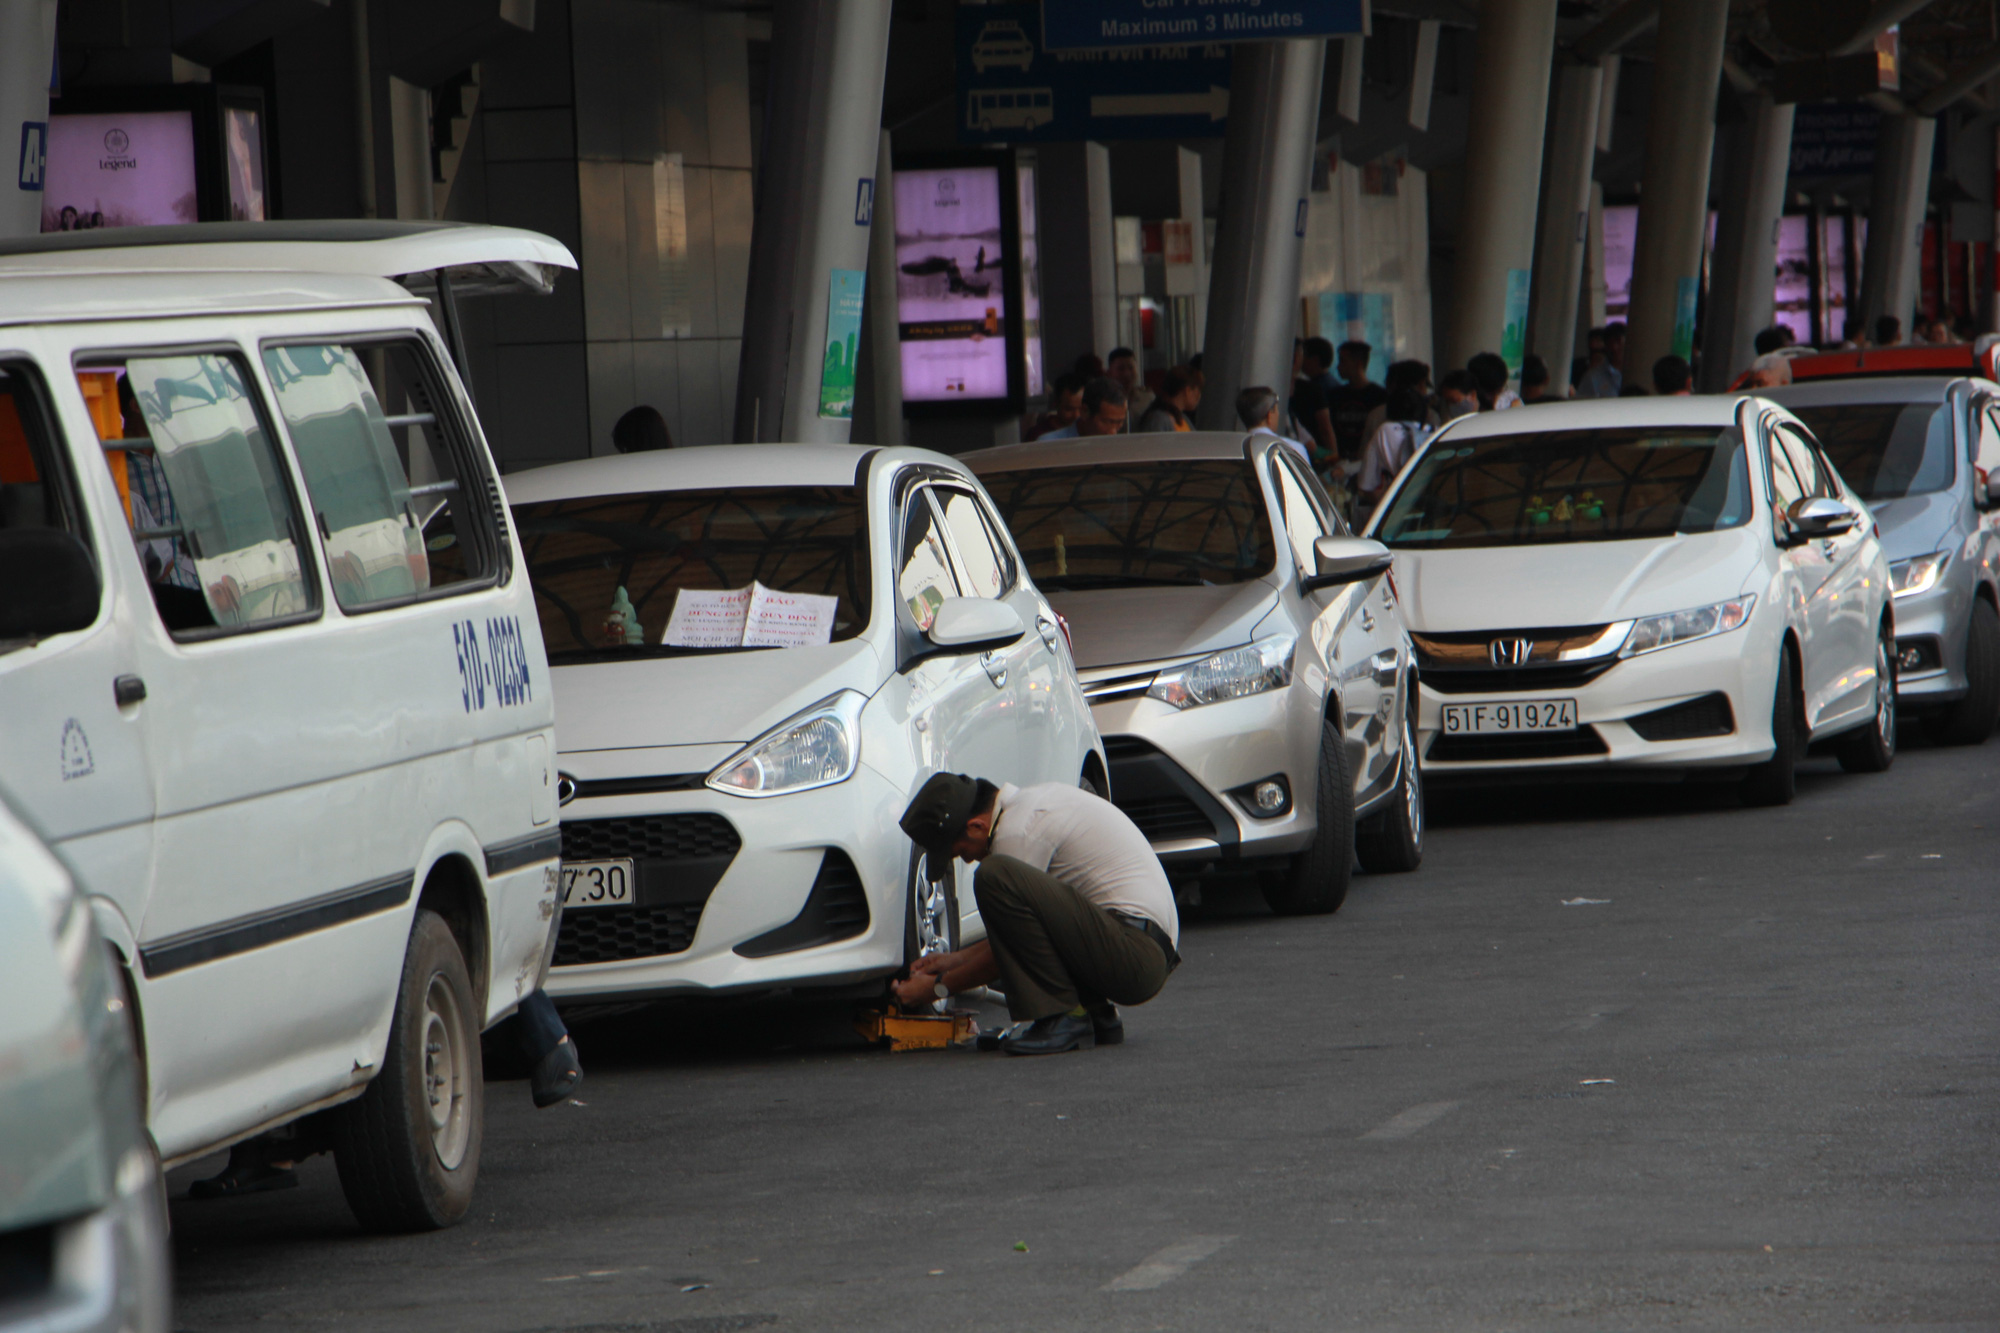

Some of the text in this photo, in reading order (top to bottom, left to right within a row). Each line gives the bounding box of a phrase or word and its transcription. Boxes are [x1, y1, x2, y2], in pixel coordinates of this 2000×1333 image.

[1101, 11, 1304, 37] Maximum 3 Minutes
[99, 157, 136, 171] Legend
[1446, 702, 1571, 732] 51F-919.24
